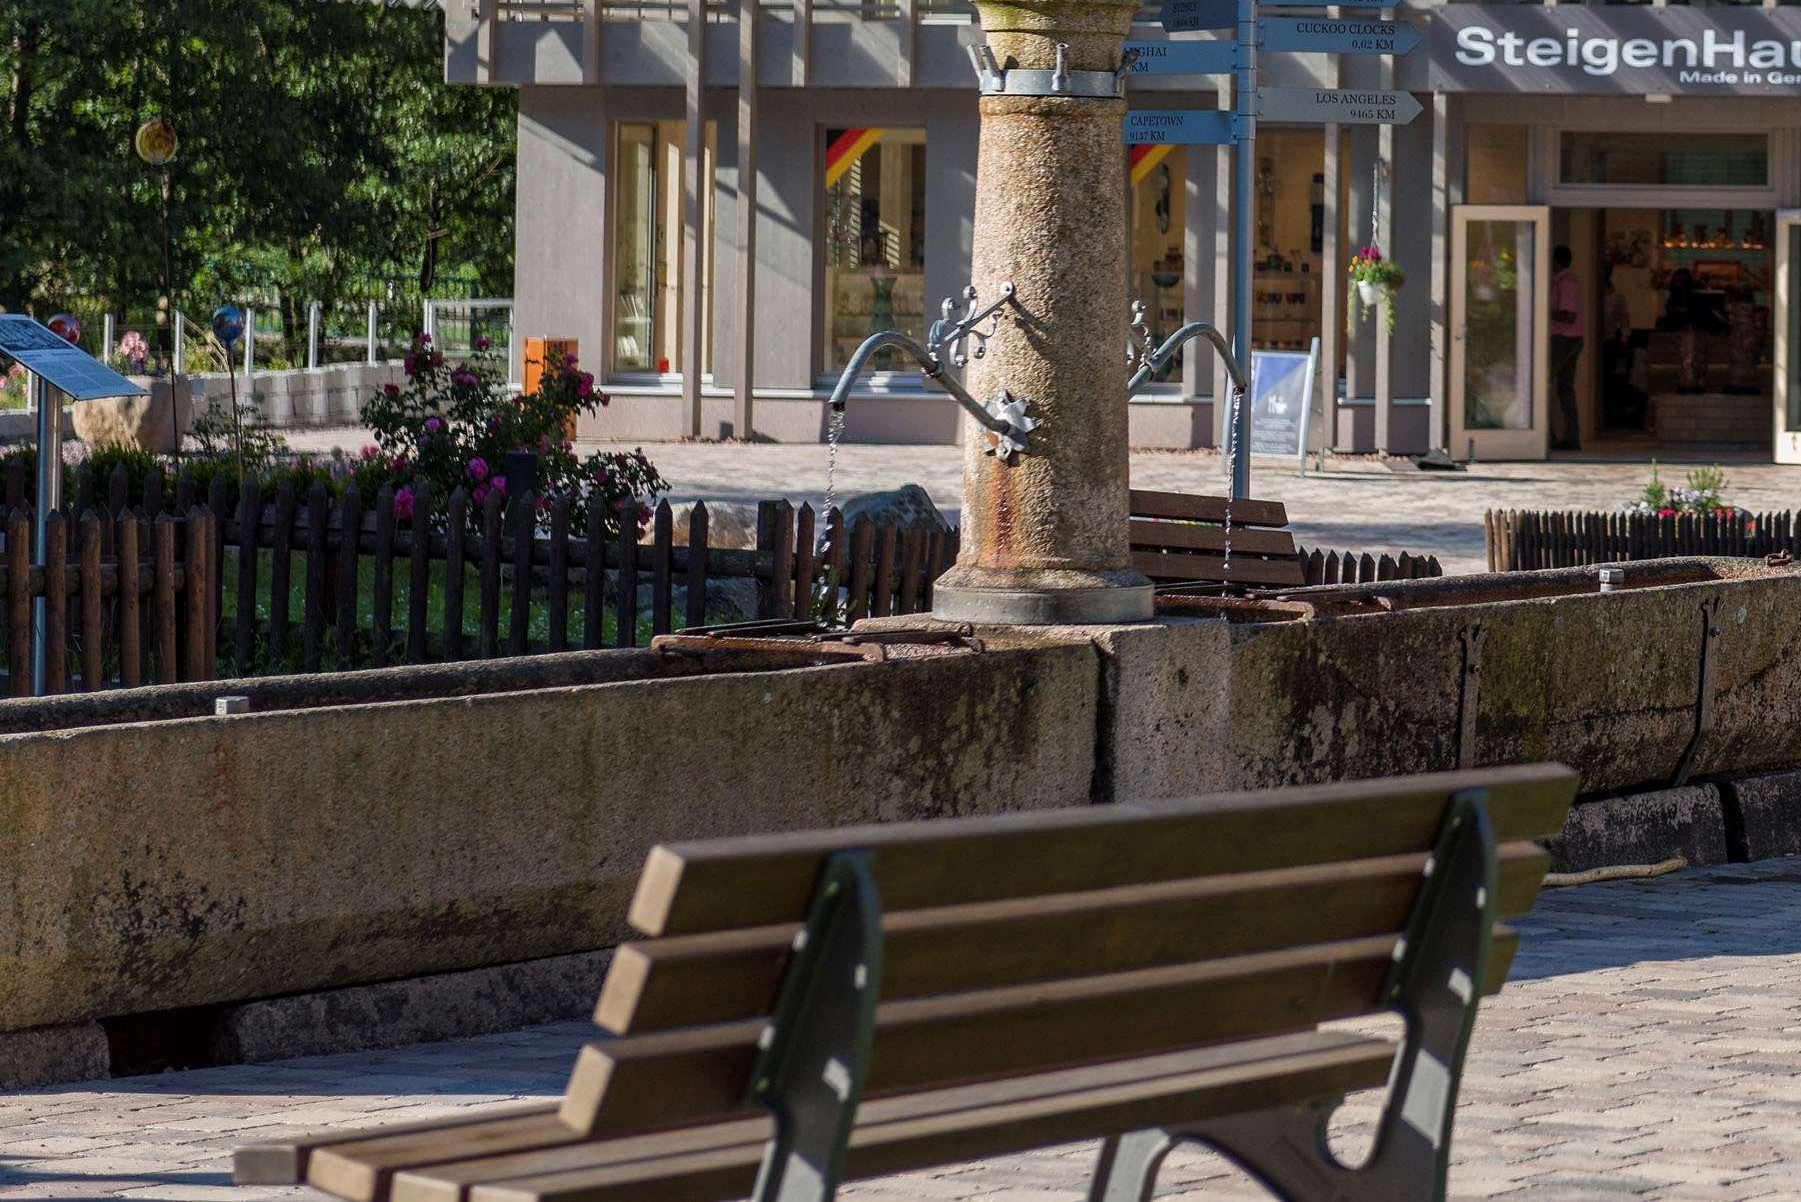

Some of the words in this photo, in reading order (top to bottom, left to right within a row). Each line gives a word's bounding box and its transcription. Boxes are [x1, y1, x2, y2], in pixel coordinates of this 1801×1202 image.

[1296, 22, 1346, 34] CUCKOO
[1349, 24, 1396, 36] CLOCKS
[1375, 39, 1394, 51] KM
[1131, 61, 1149, 72] KM
[1679, 71, 1738, 85] Made
[1743, 71, 1761, 85] in
[1316, 93, 1338, 104] LOS
[1340, 94, 1397, 106] ANGELES
[1377, 109, 1395, 119] KM
[1130, 115, 1184, 126] CAPETOWN
[1150, 130, 1166, 141] KM
